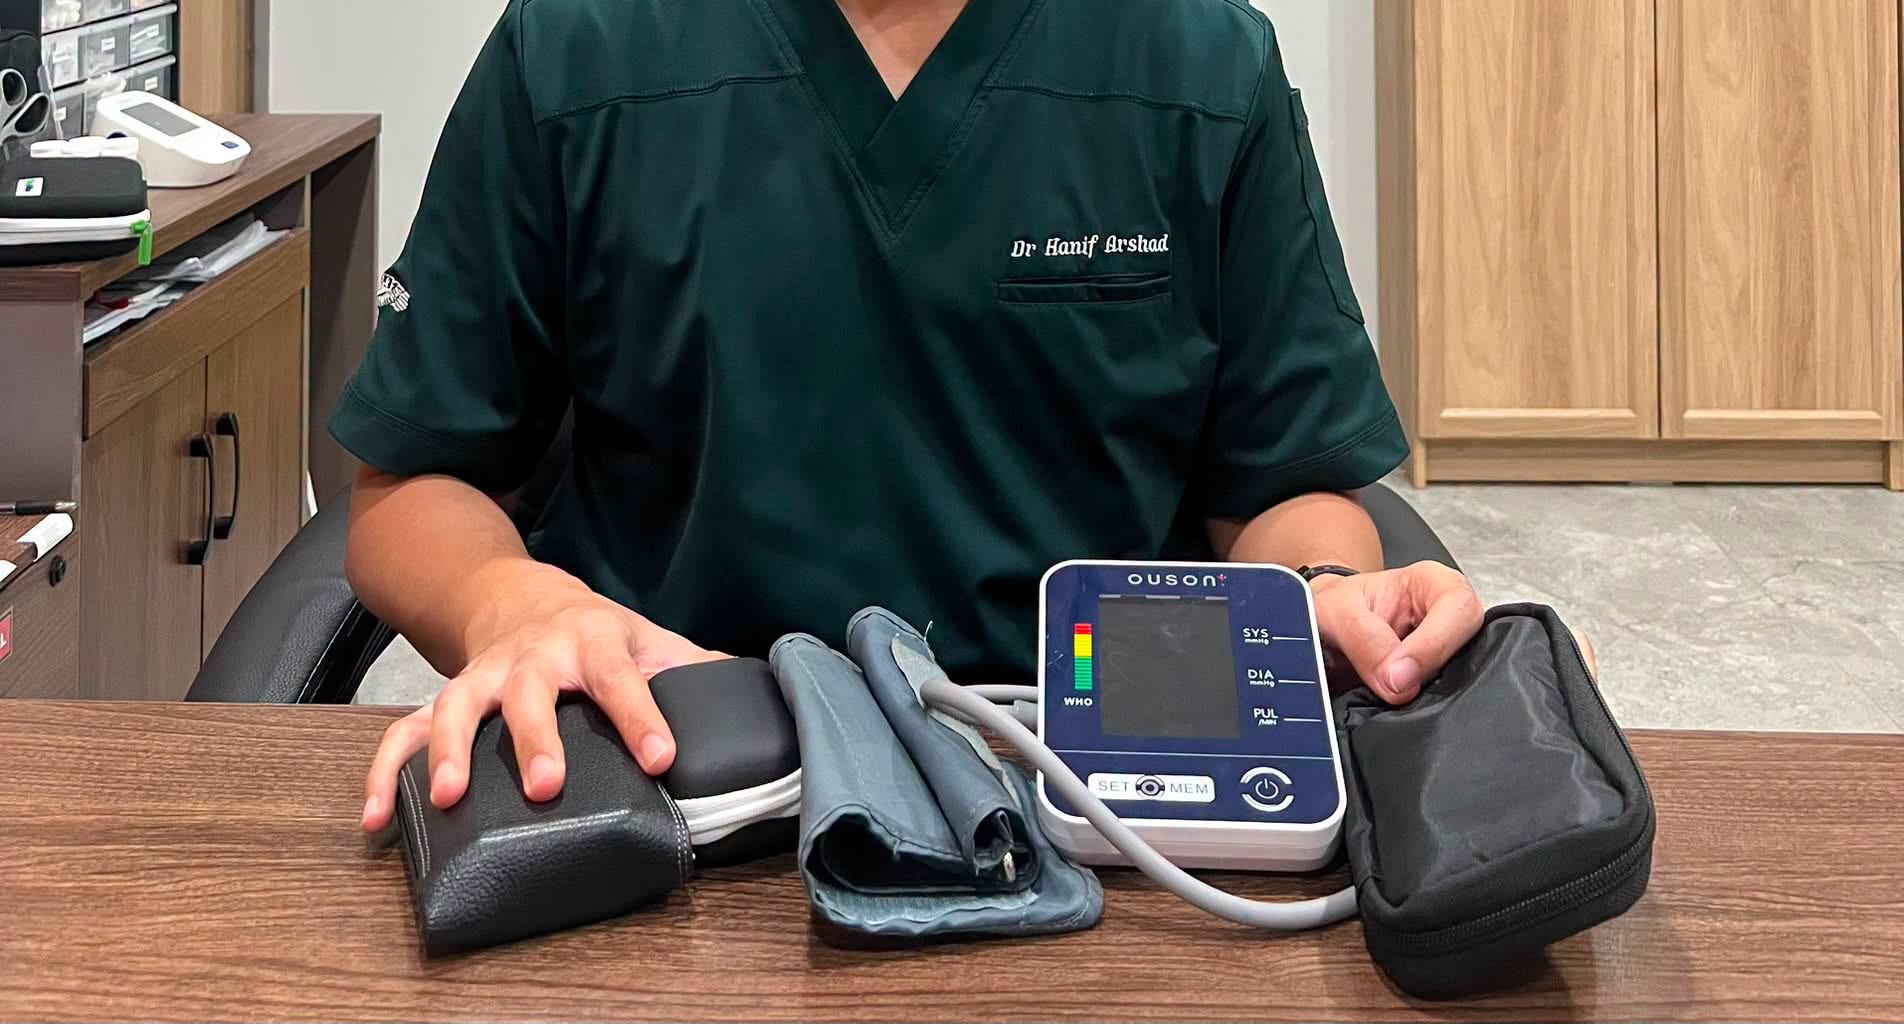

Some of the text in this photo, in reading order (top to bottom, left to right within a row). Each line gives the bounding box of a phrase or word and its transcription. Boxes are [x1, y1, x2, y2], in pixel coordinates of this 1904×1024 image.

[1011, 233, 1170, 259] Dr Hanif Arshad
[1242, 627, 1269, 638] SYS
[1244, 638, 1270, 646] mmHg
[1247, 668, 1275, 680] DIA
[1249, 679, 1276, 688] mmHg
[1063, 696, 1093, 707] WHO
[1253, 707, 1279, 719] PUL
[1098, 780, 1209, 795] SET MEM
